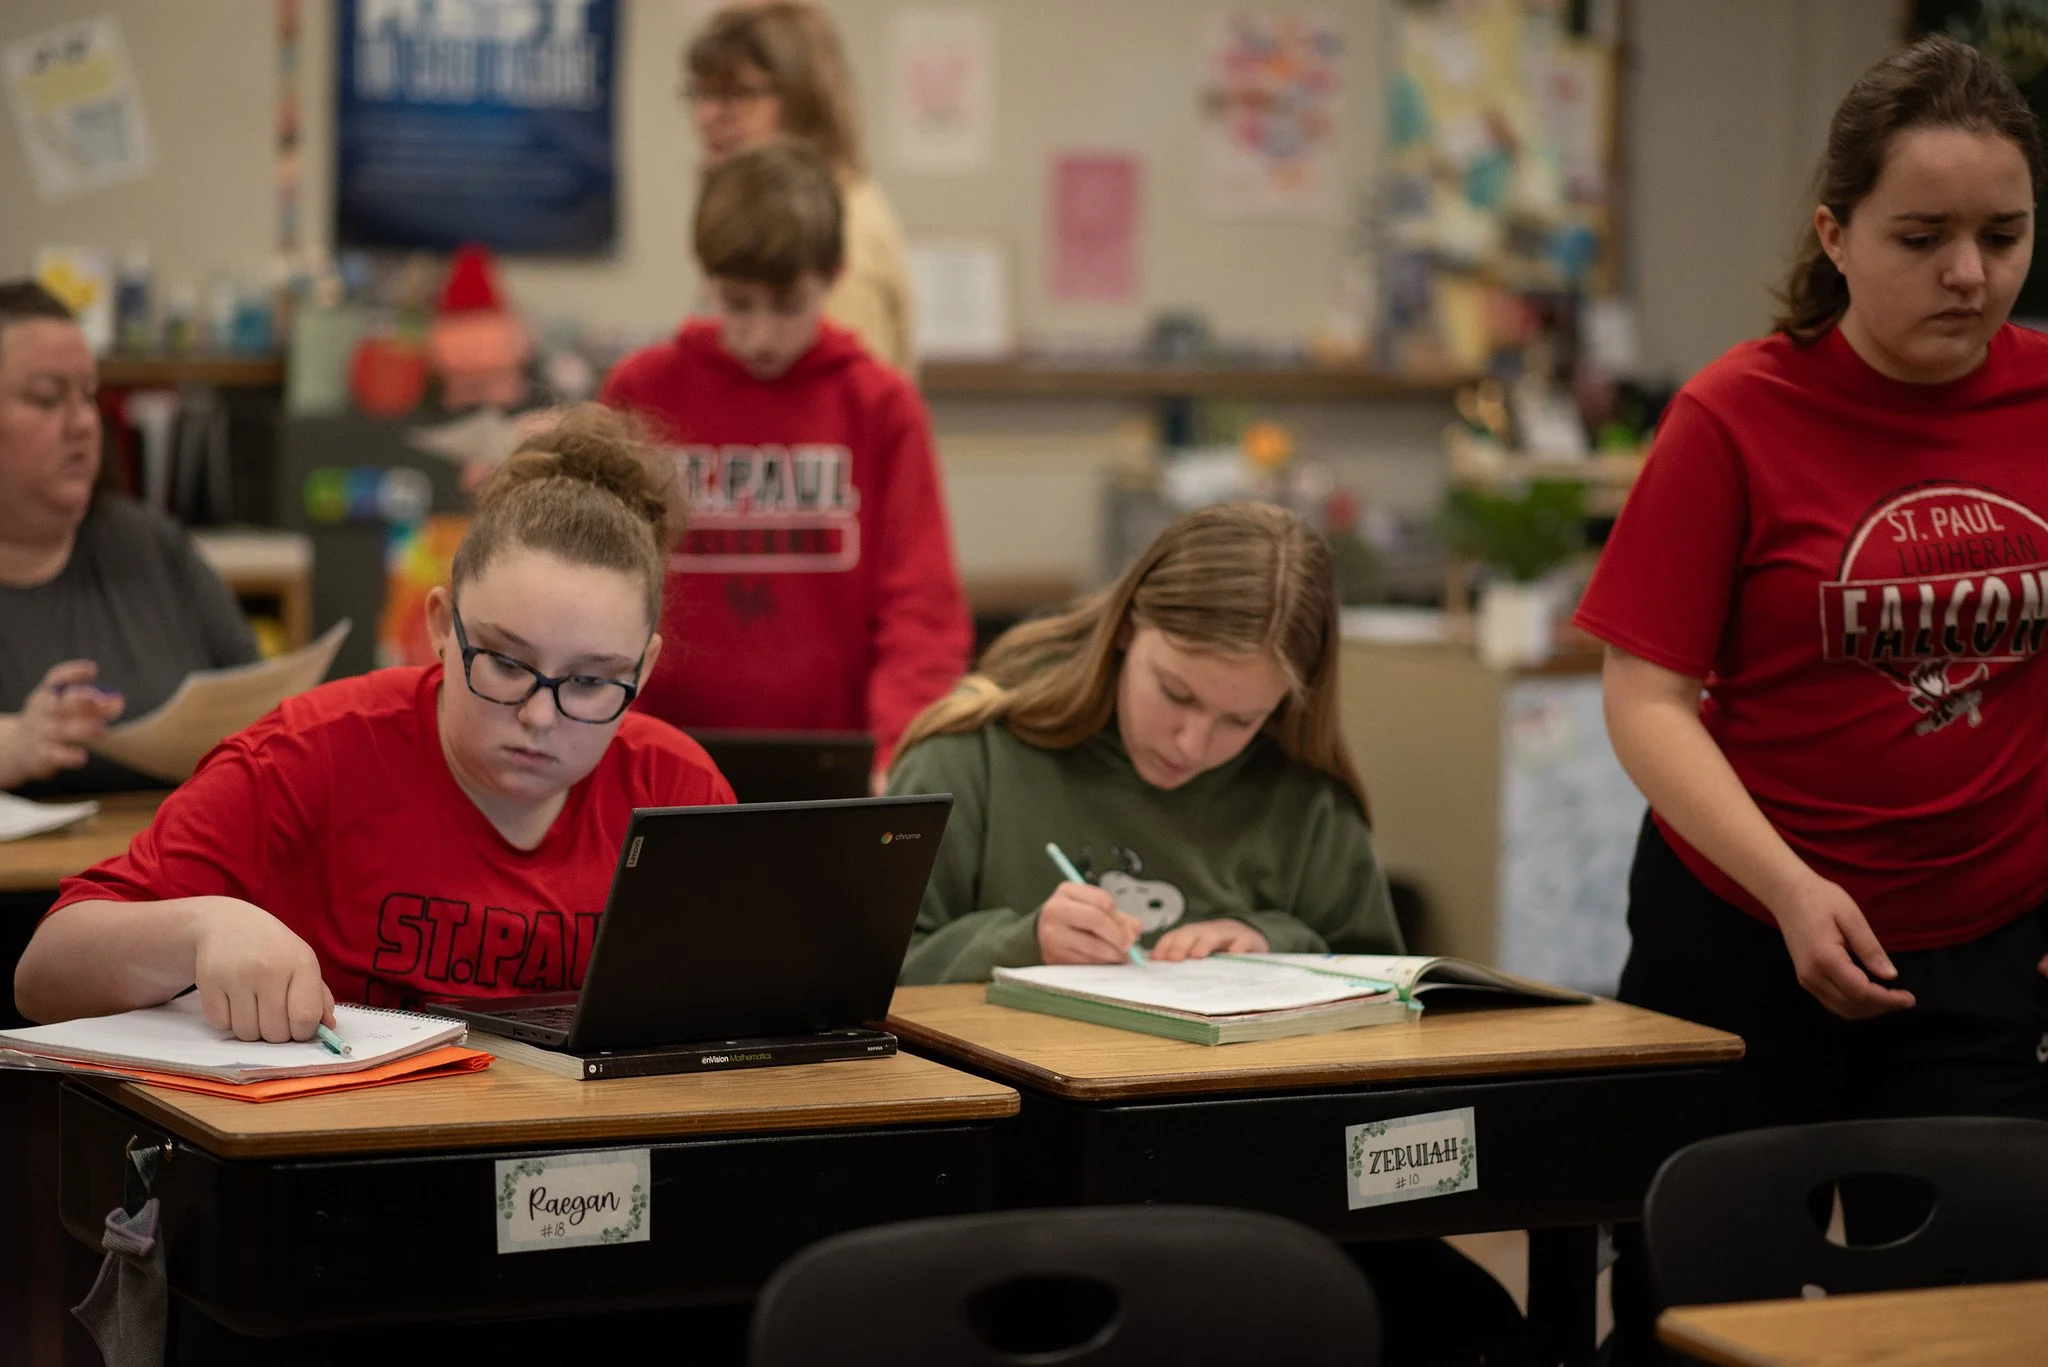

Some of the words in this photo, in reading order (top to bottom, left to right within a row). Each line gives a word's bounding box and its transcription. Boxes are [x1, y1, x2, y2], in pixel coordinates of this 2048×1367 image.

[674, 445, 861, 515] T.PAUL
[1886, 509, 1928, 543] ST.
[1931, 502, 2005, 538] PAUL
[1898, 533, 2039, 577] LUTHERAN
[895, 833, 921, 841] chrome
[702, 1055, 729, 1064] enVision
[730, 1053, 771, 1062] Mathematics
[1369, 1138, 1458, 1175] ZERUIAH
[1395, 1173, 1420, 1189] #10
[529, 1186, 620, 1226] Raegan
[541, 1221, 566, 1238] #18
